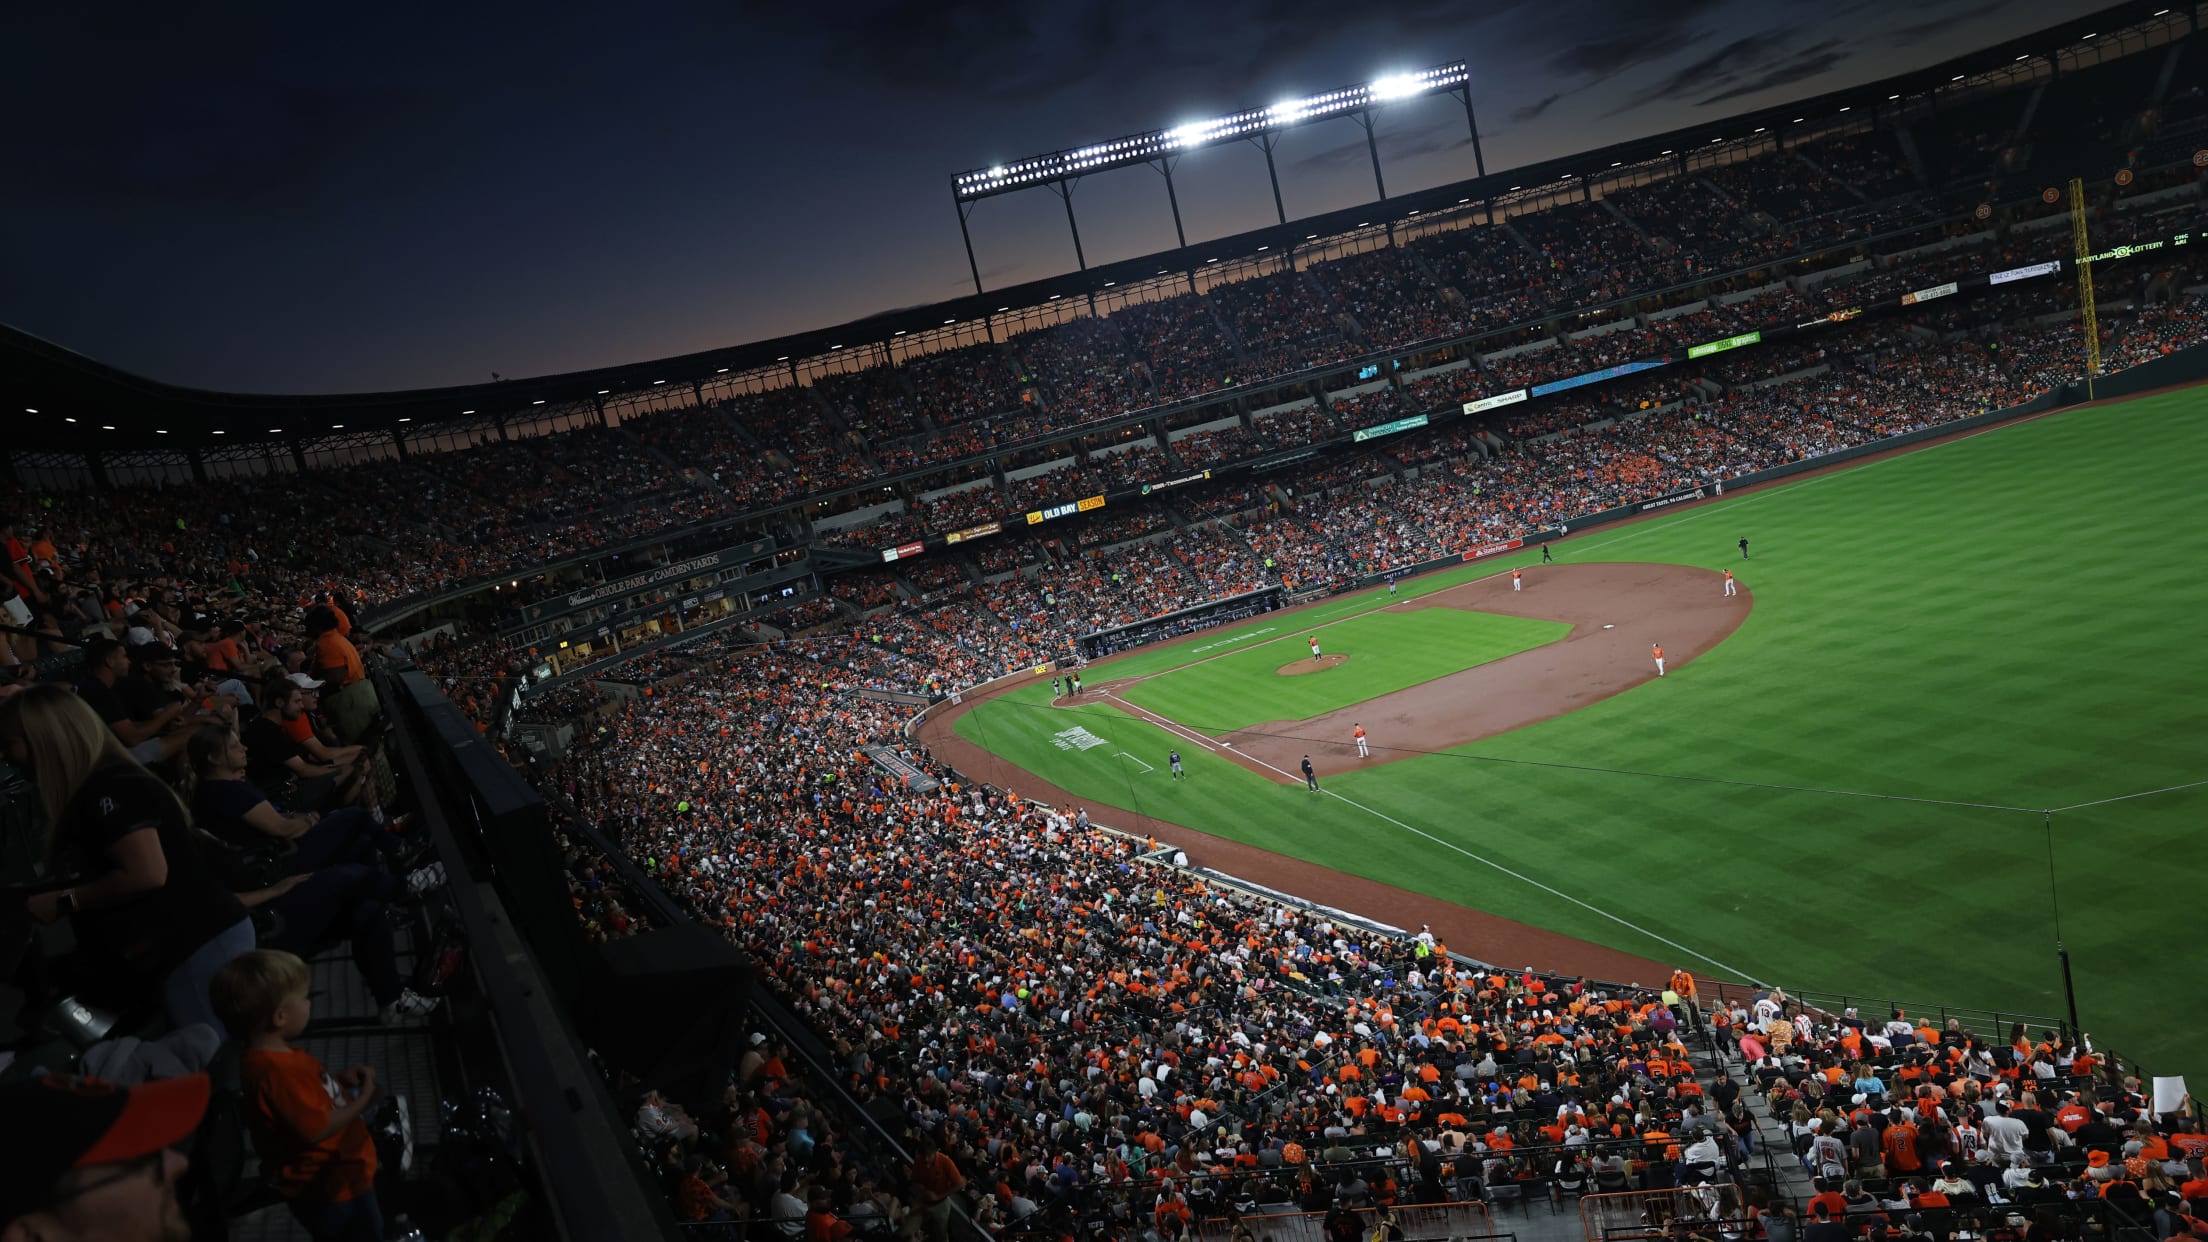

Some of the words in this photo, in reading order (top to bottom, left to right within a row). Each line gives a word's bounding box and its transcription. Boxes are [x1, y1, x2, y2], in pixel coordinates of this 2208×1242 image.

[2131, 241, 2164, 254] LOTTERY
[1044, 507, 1060, 519] OLD
[1060, 503, 1076, 515] BAY
[1079, 496, 1103, 510] SEASON
[595, 581, 625, 599] ORIOLE
[624, 575, 648, 590] PARK
[654, 562, 691, 581] CAMDEN
[690, 555, 719, 570] YARDS
[1761, 1007, 1770, 1018] 13
